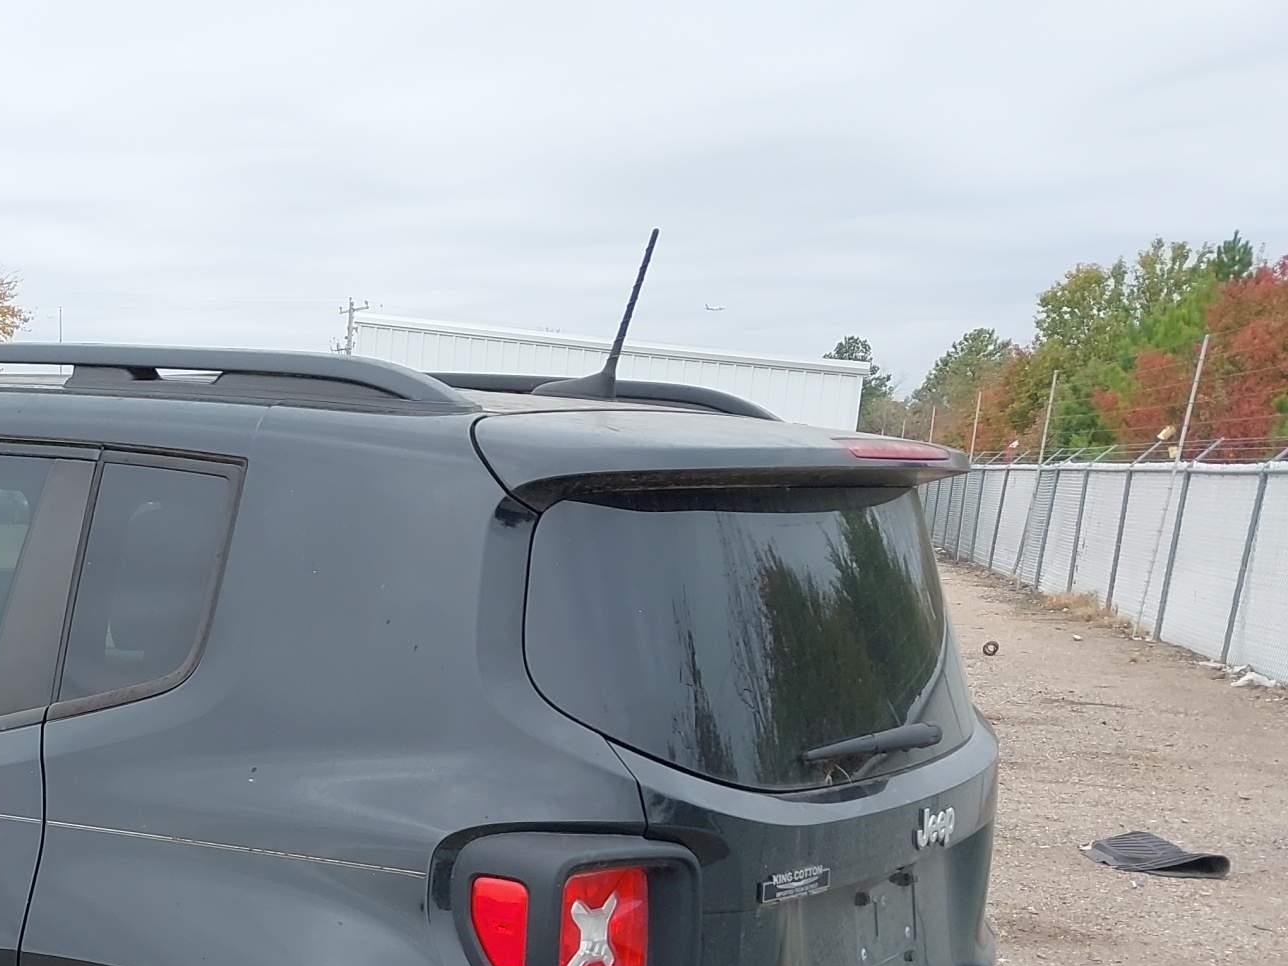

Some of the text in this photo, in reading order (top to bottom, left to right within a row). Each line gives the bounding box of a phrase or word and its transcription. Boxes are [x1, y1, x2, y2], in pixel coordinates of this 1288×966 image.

[916, 807, 955, 849] Jeep
[772, 864, 824, 886] KING COTTON
